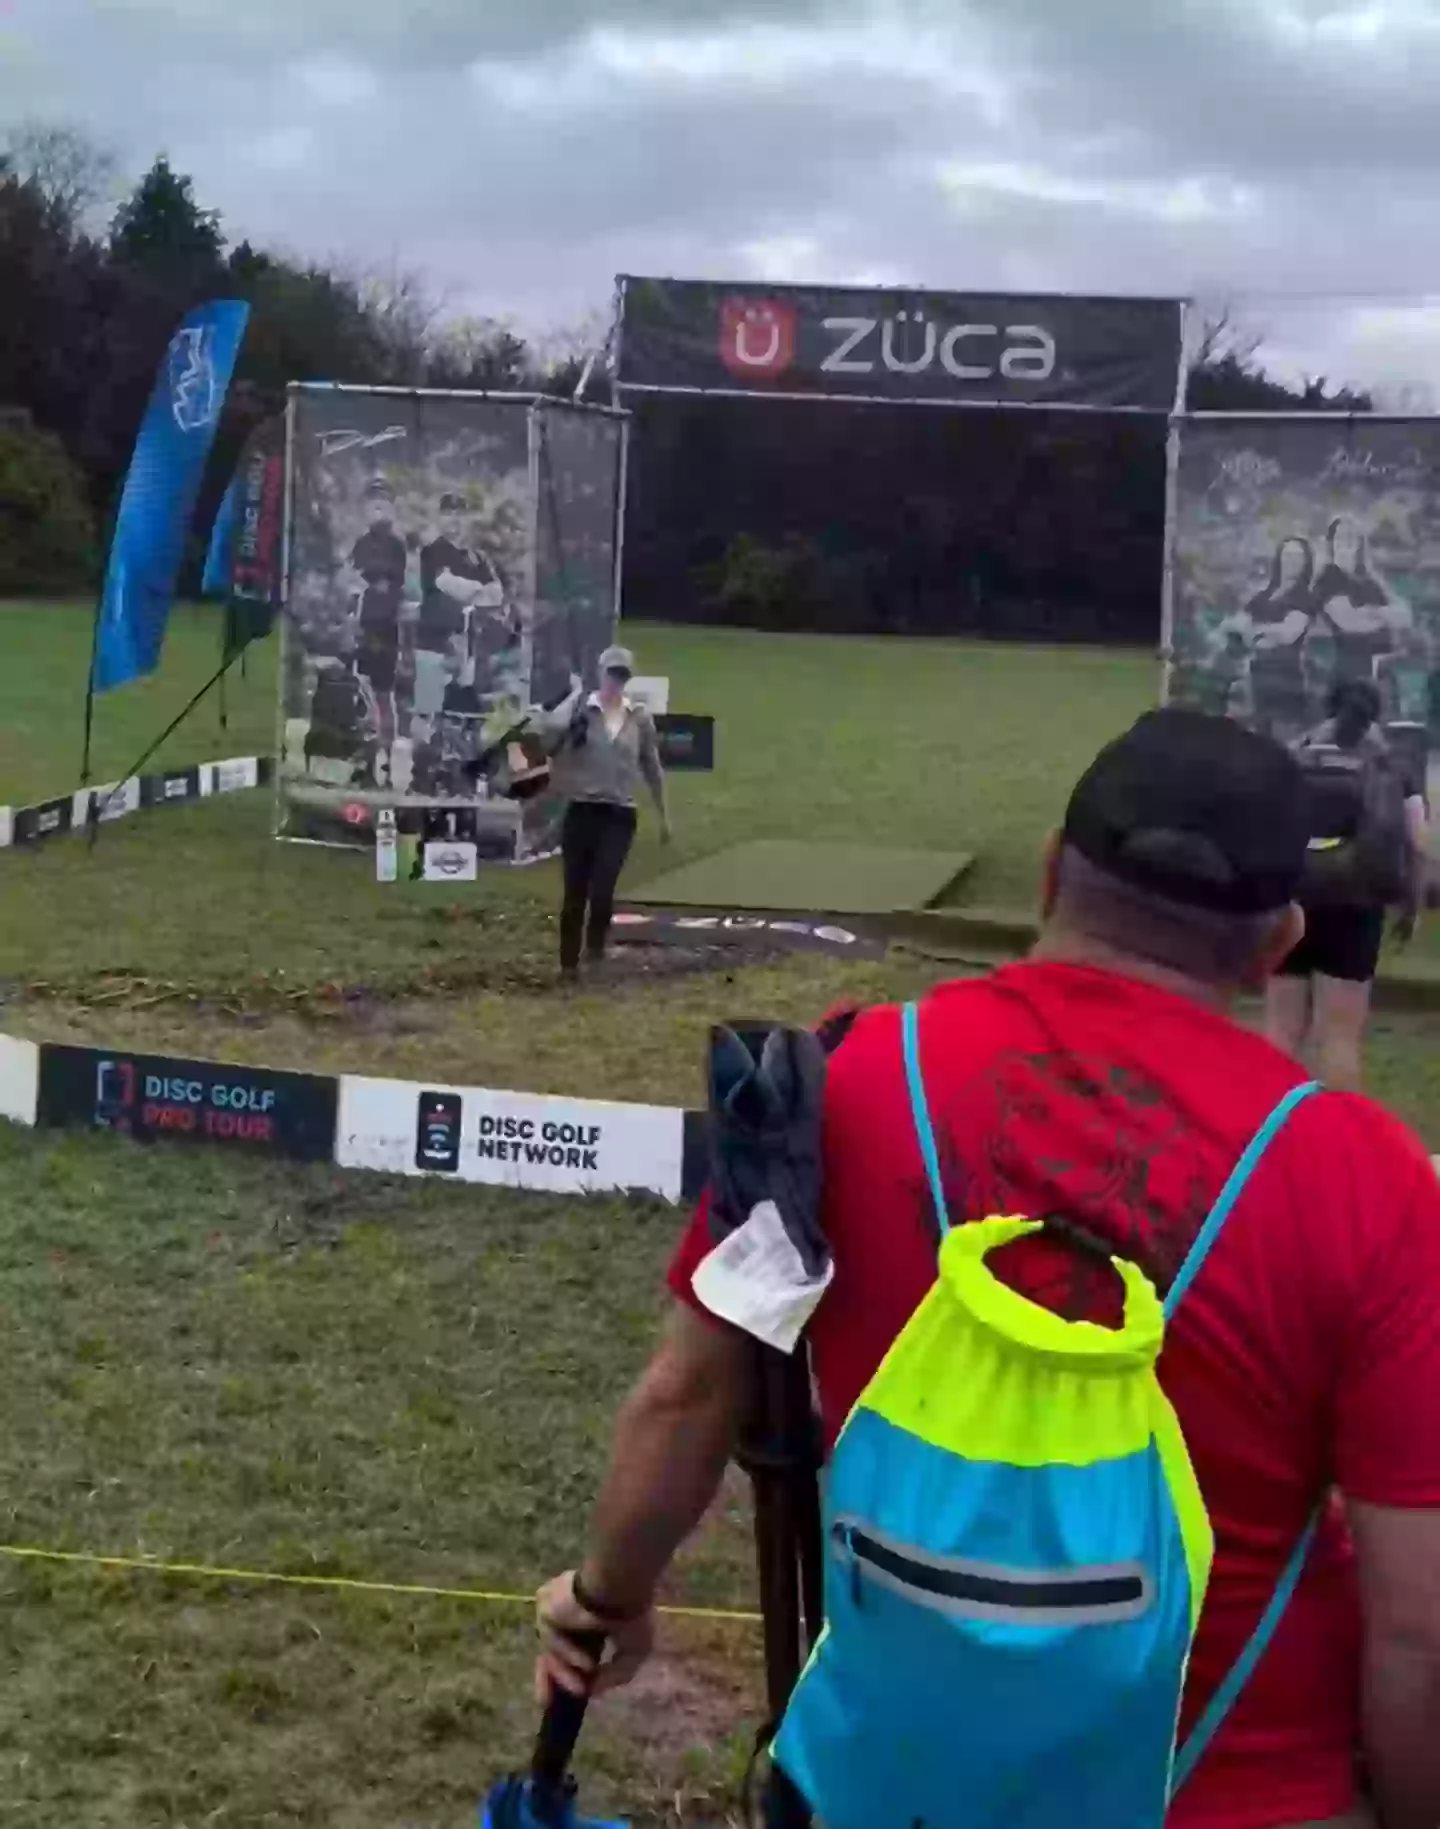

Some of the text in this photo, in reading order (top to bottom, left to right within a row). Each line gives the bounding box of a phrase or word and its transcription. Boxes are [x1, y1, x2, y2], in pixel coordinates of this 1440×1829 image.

[145, 1075, 275, 1112] DISC GOLF
[142, 1104, 273, 1140] PRO TOUR
[479, 1115, 601, 1146] DISC GOLF
[477, 1139, 599, 1170] NETWORK
